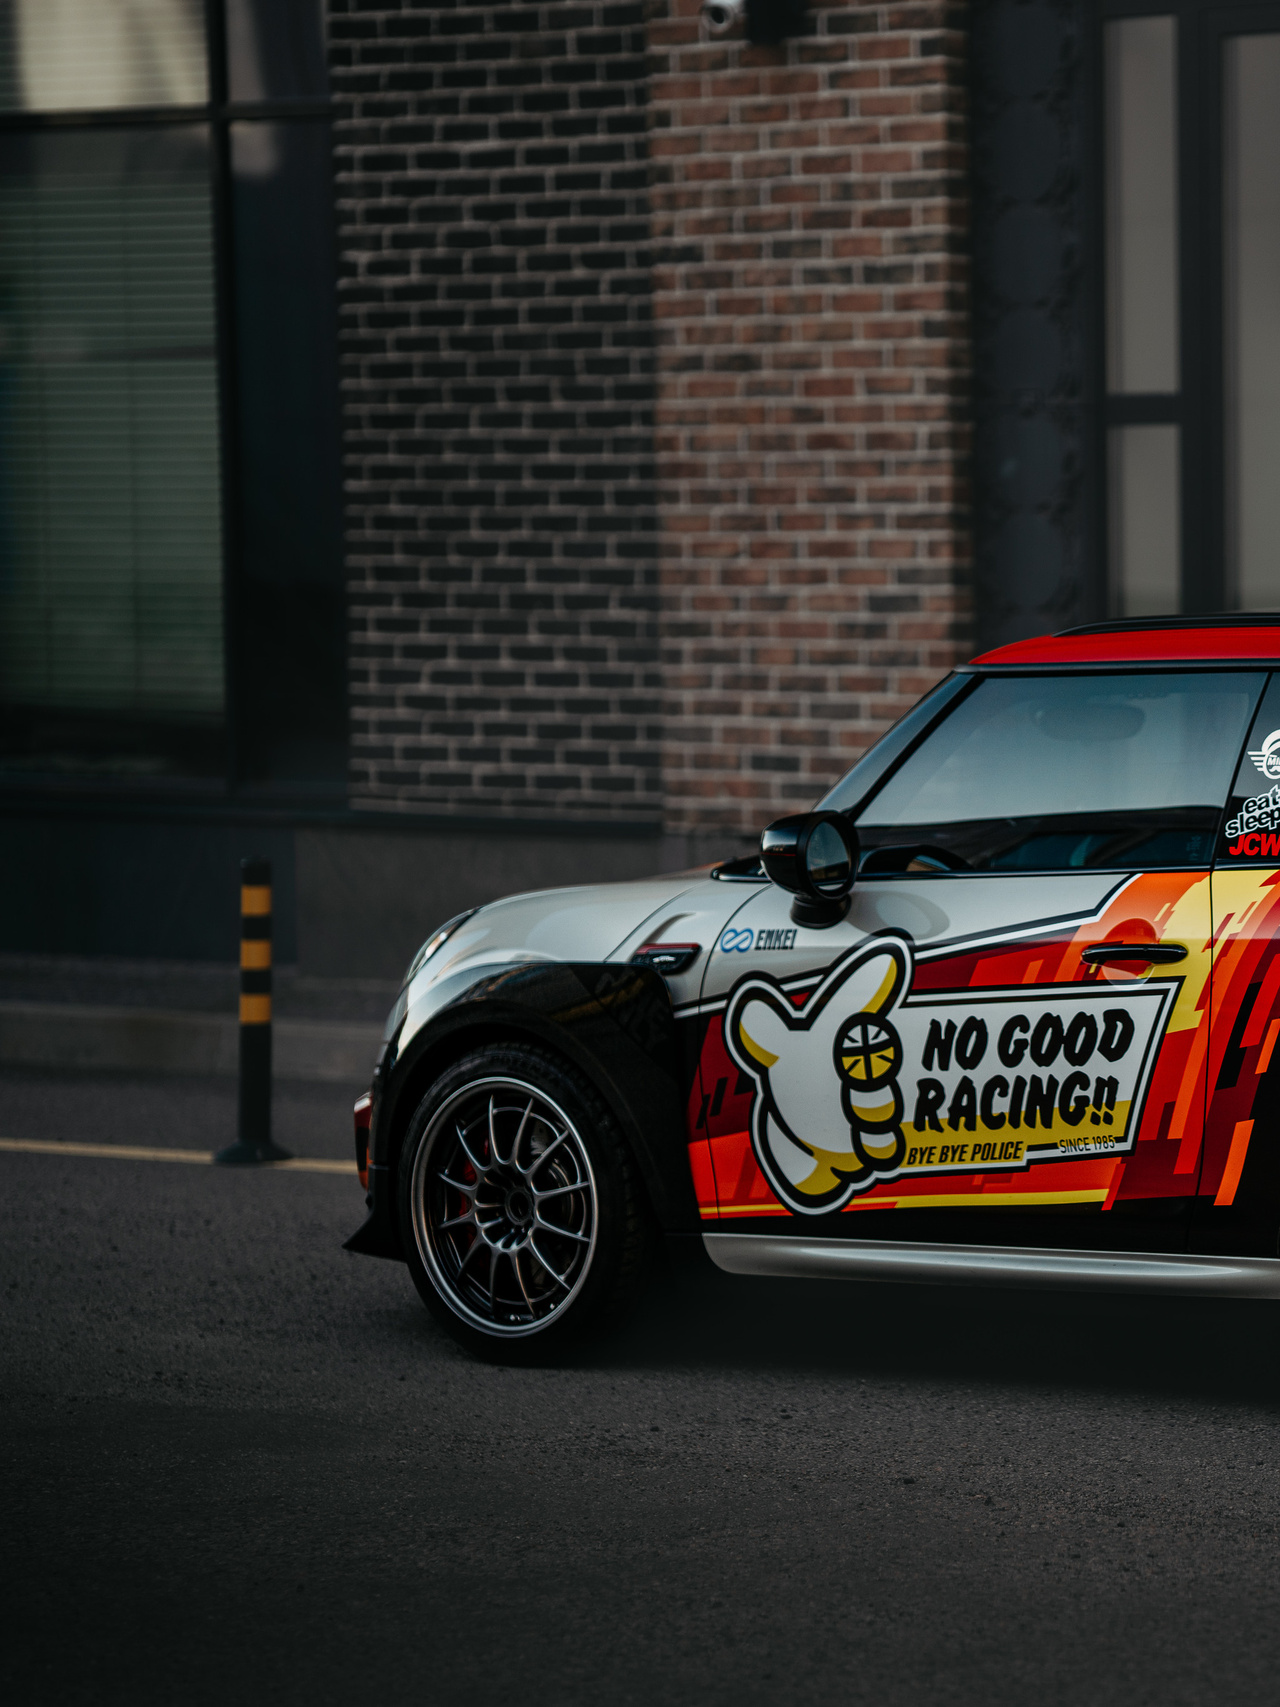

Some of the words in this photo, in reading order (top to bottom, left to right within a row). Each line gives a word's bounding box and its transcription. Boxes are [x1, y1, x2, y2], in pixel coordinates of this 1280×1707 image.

[1243, 784, 1280, 815] eat
[754, 928, 798, 951] ENKEI
[921, 1015, 989, 1071] NO
[997, 1008, 1135, 1068] GOOD
[913, 1070, 1120, 1133] RACING!!
[906, 1147, 937, 1166] BYE
[938, 1144, 970, 1164] BYE
[970, 1140, 1024, 1162] POLICE
[1059, 1137, 1090, 1154] SINCE
[1092, 1134, 1116, 1150] 1985
